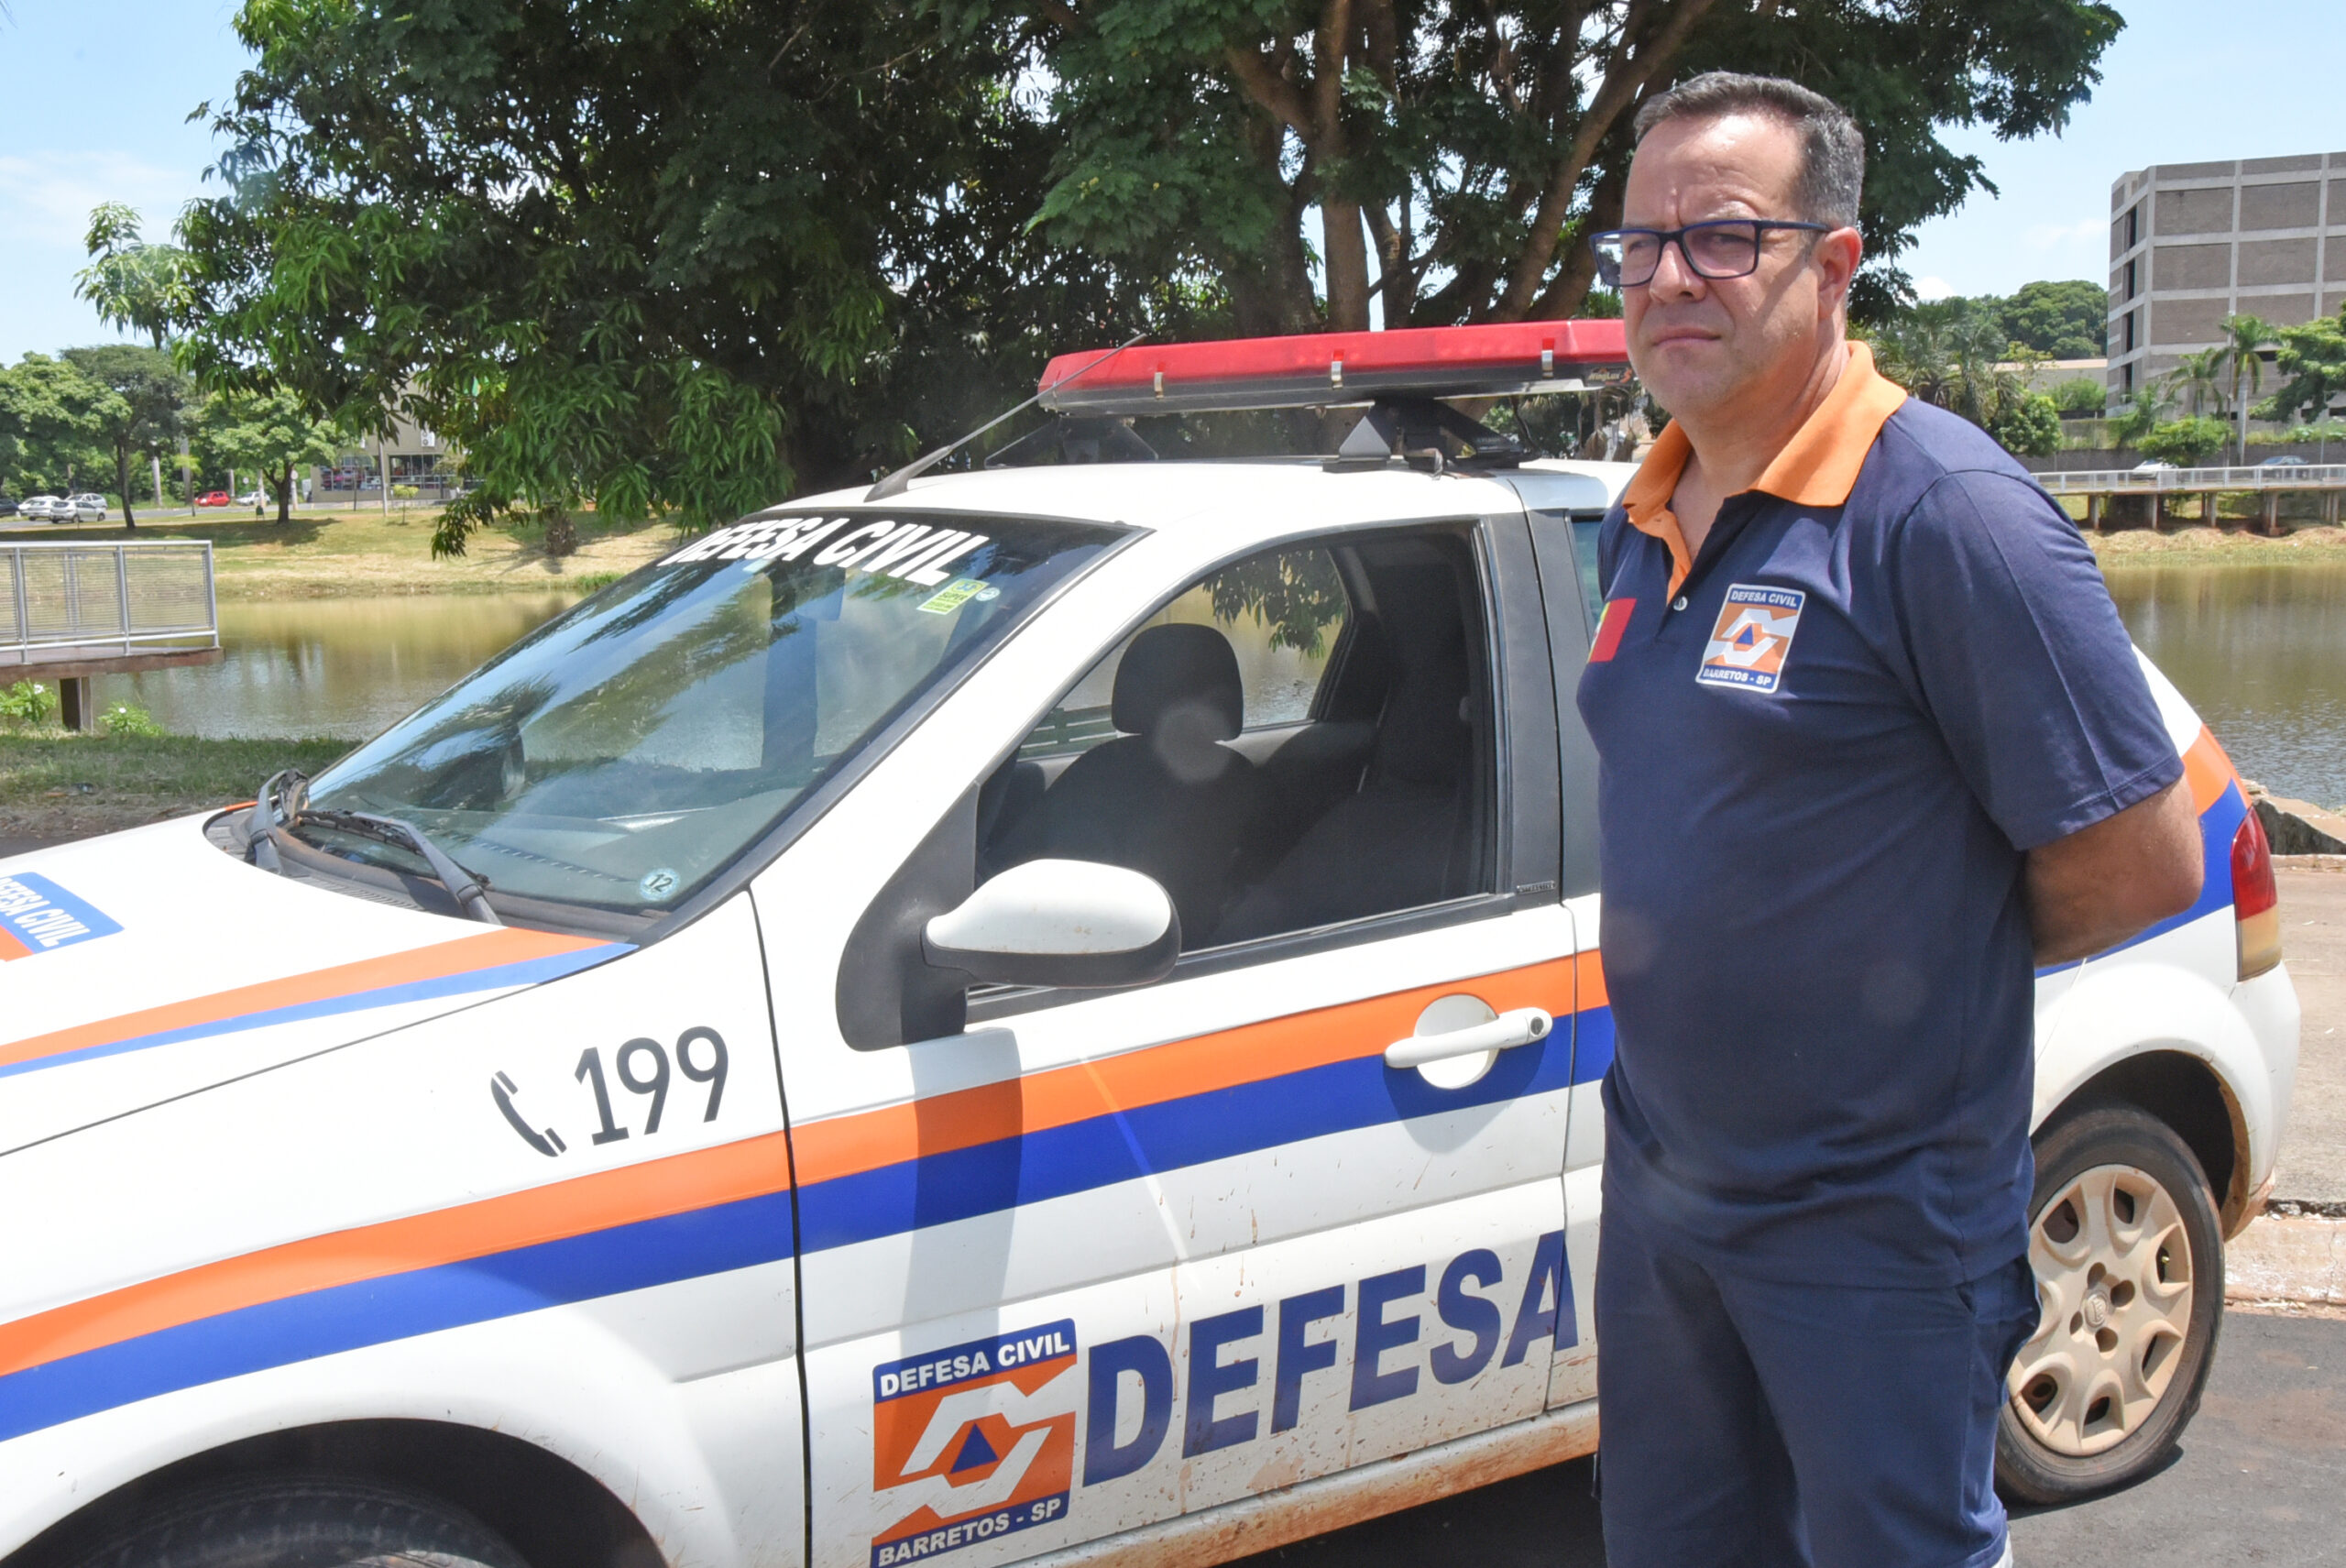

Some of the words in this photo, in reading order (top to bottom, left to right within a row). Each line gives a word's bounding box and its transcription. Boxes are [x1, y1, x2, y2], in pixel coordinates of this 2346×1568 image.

[656, 517, 850, 566] DEFESA
[813, 521, 989, 587] CIVIL
[1730, 590, 1767, 602] DEFESA
[1768, 594, 1797, 607] CIVIL
[1756, 674, 1771, 685] SP
[0, 877, 51, 916] FESA
[649, 873, 674, 893] 12
[14, 908, 91, 948] CIVIL
[575, 1025, 729, 1146] 199
[880, 1351, 991, 1397] DEFESA
[998, 1332, 1070, 1366] CIVIL
[1082, 1229, 1578, 1487] DEFESA
[878, 1512, 1010, 1567] BARRETOS
[1030, 1497, 1061, 1521] SP
